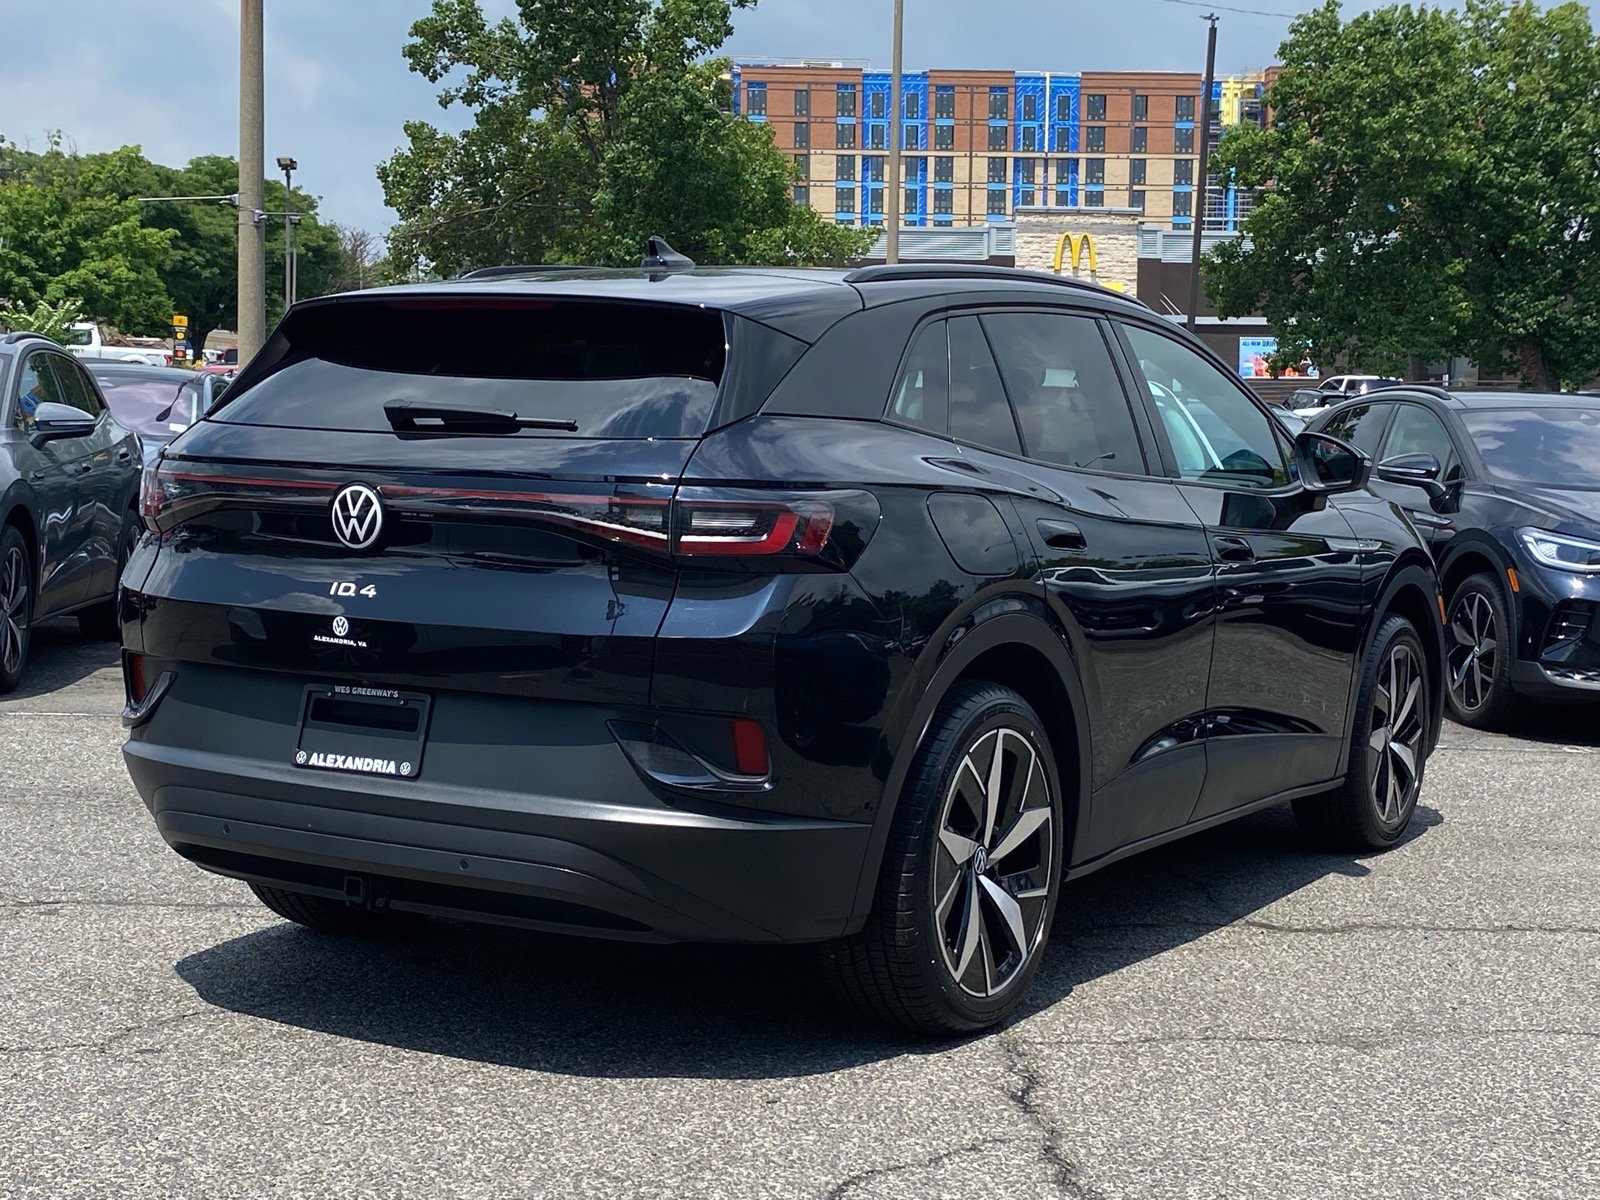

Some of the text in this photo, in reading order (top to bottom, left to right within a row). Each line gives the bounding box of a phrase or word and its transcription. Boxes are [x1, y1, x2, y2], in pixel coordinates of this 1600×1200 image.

[332, 485, 382, 549] VW
[314, 635, 356, 646] ALEXANDRIA,
[334, 685, 399, 698] WES GREENWAY'S
[309, 753, 396, 774] ALEXANDRIA
